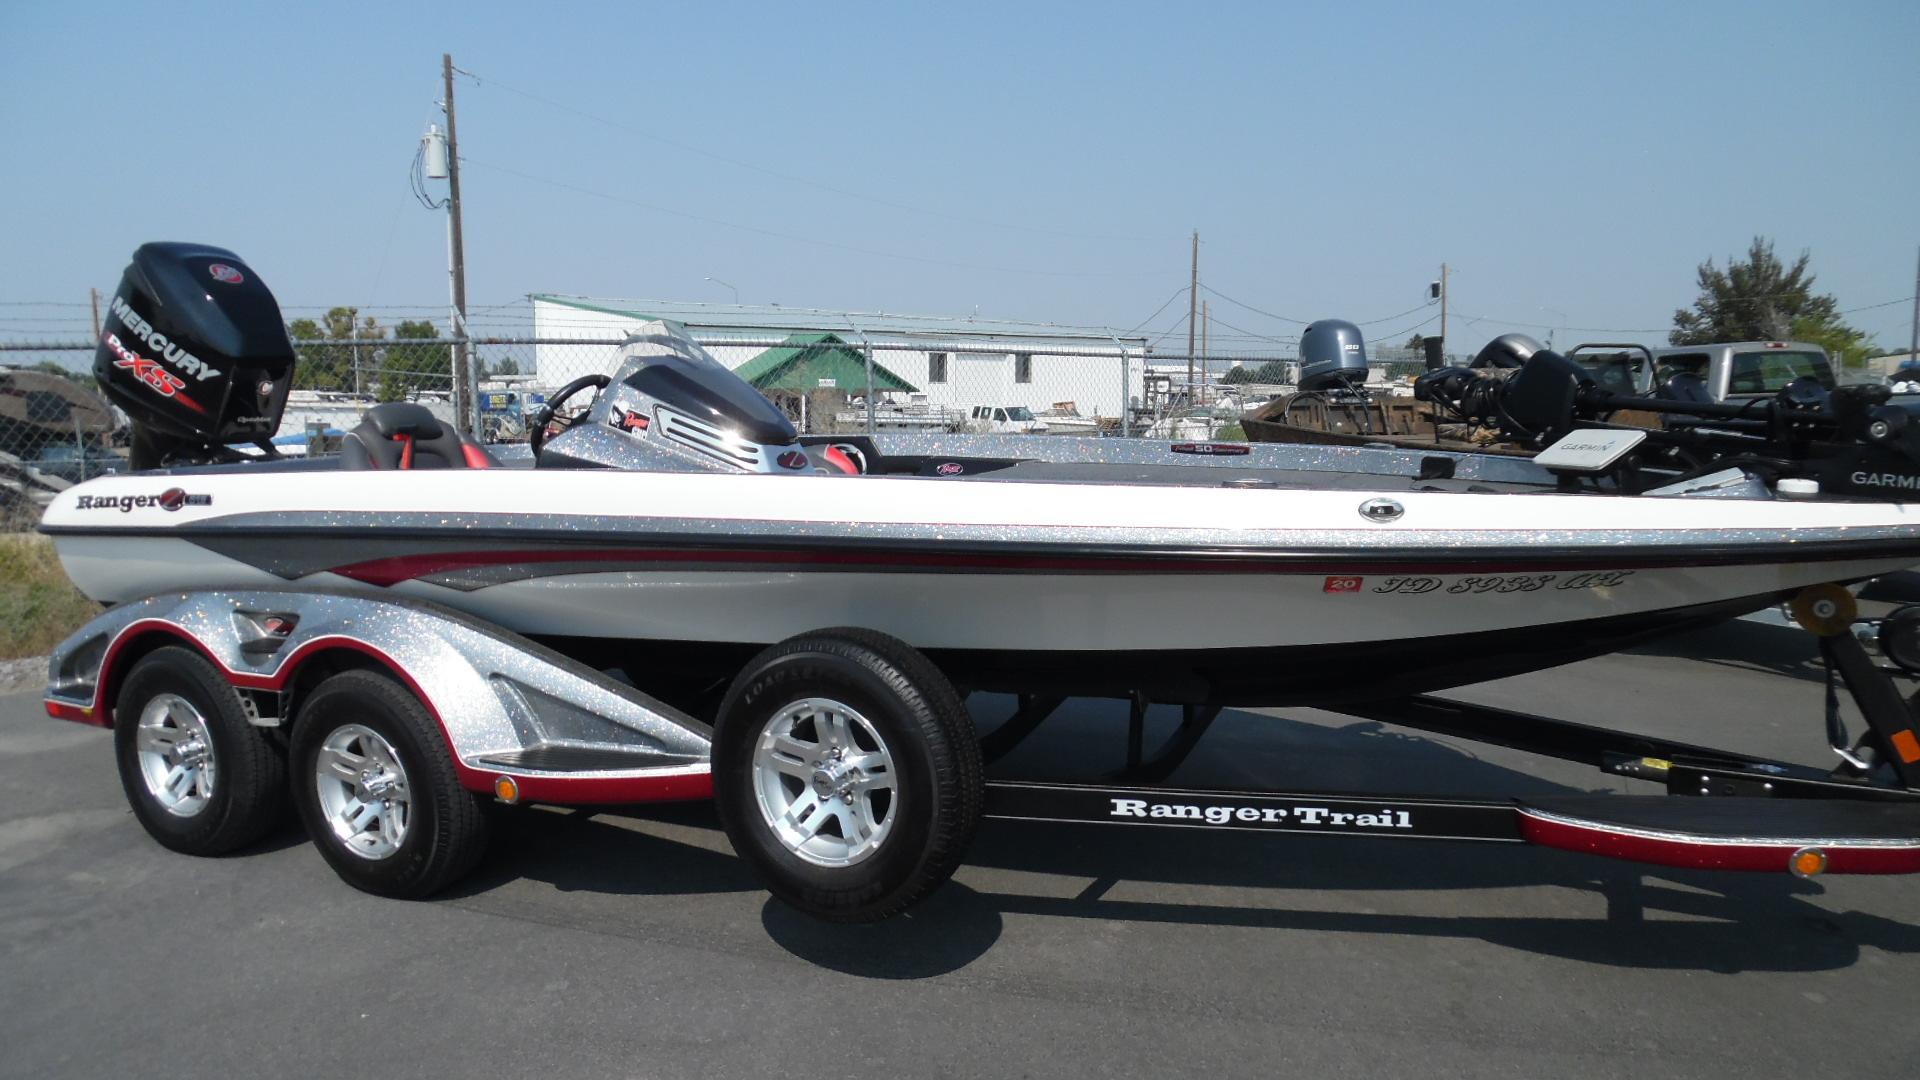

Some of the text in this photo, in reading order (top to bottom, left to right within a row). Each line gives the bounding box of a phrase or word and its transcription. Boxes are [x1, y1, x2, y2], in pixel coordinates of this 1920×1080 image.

[112, 296, 221, 382] MERCURY
[113, 350, 186, 397] XS
[1560, 442, 1610, 452] GARMIN
[76, 493, 162, 513] Ranger
[1331, 579, 1357, 590] 20
[1110, 798, 1414, 828] Ranger Trail
